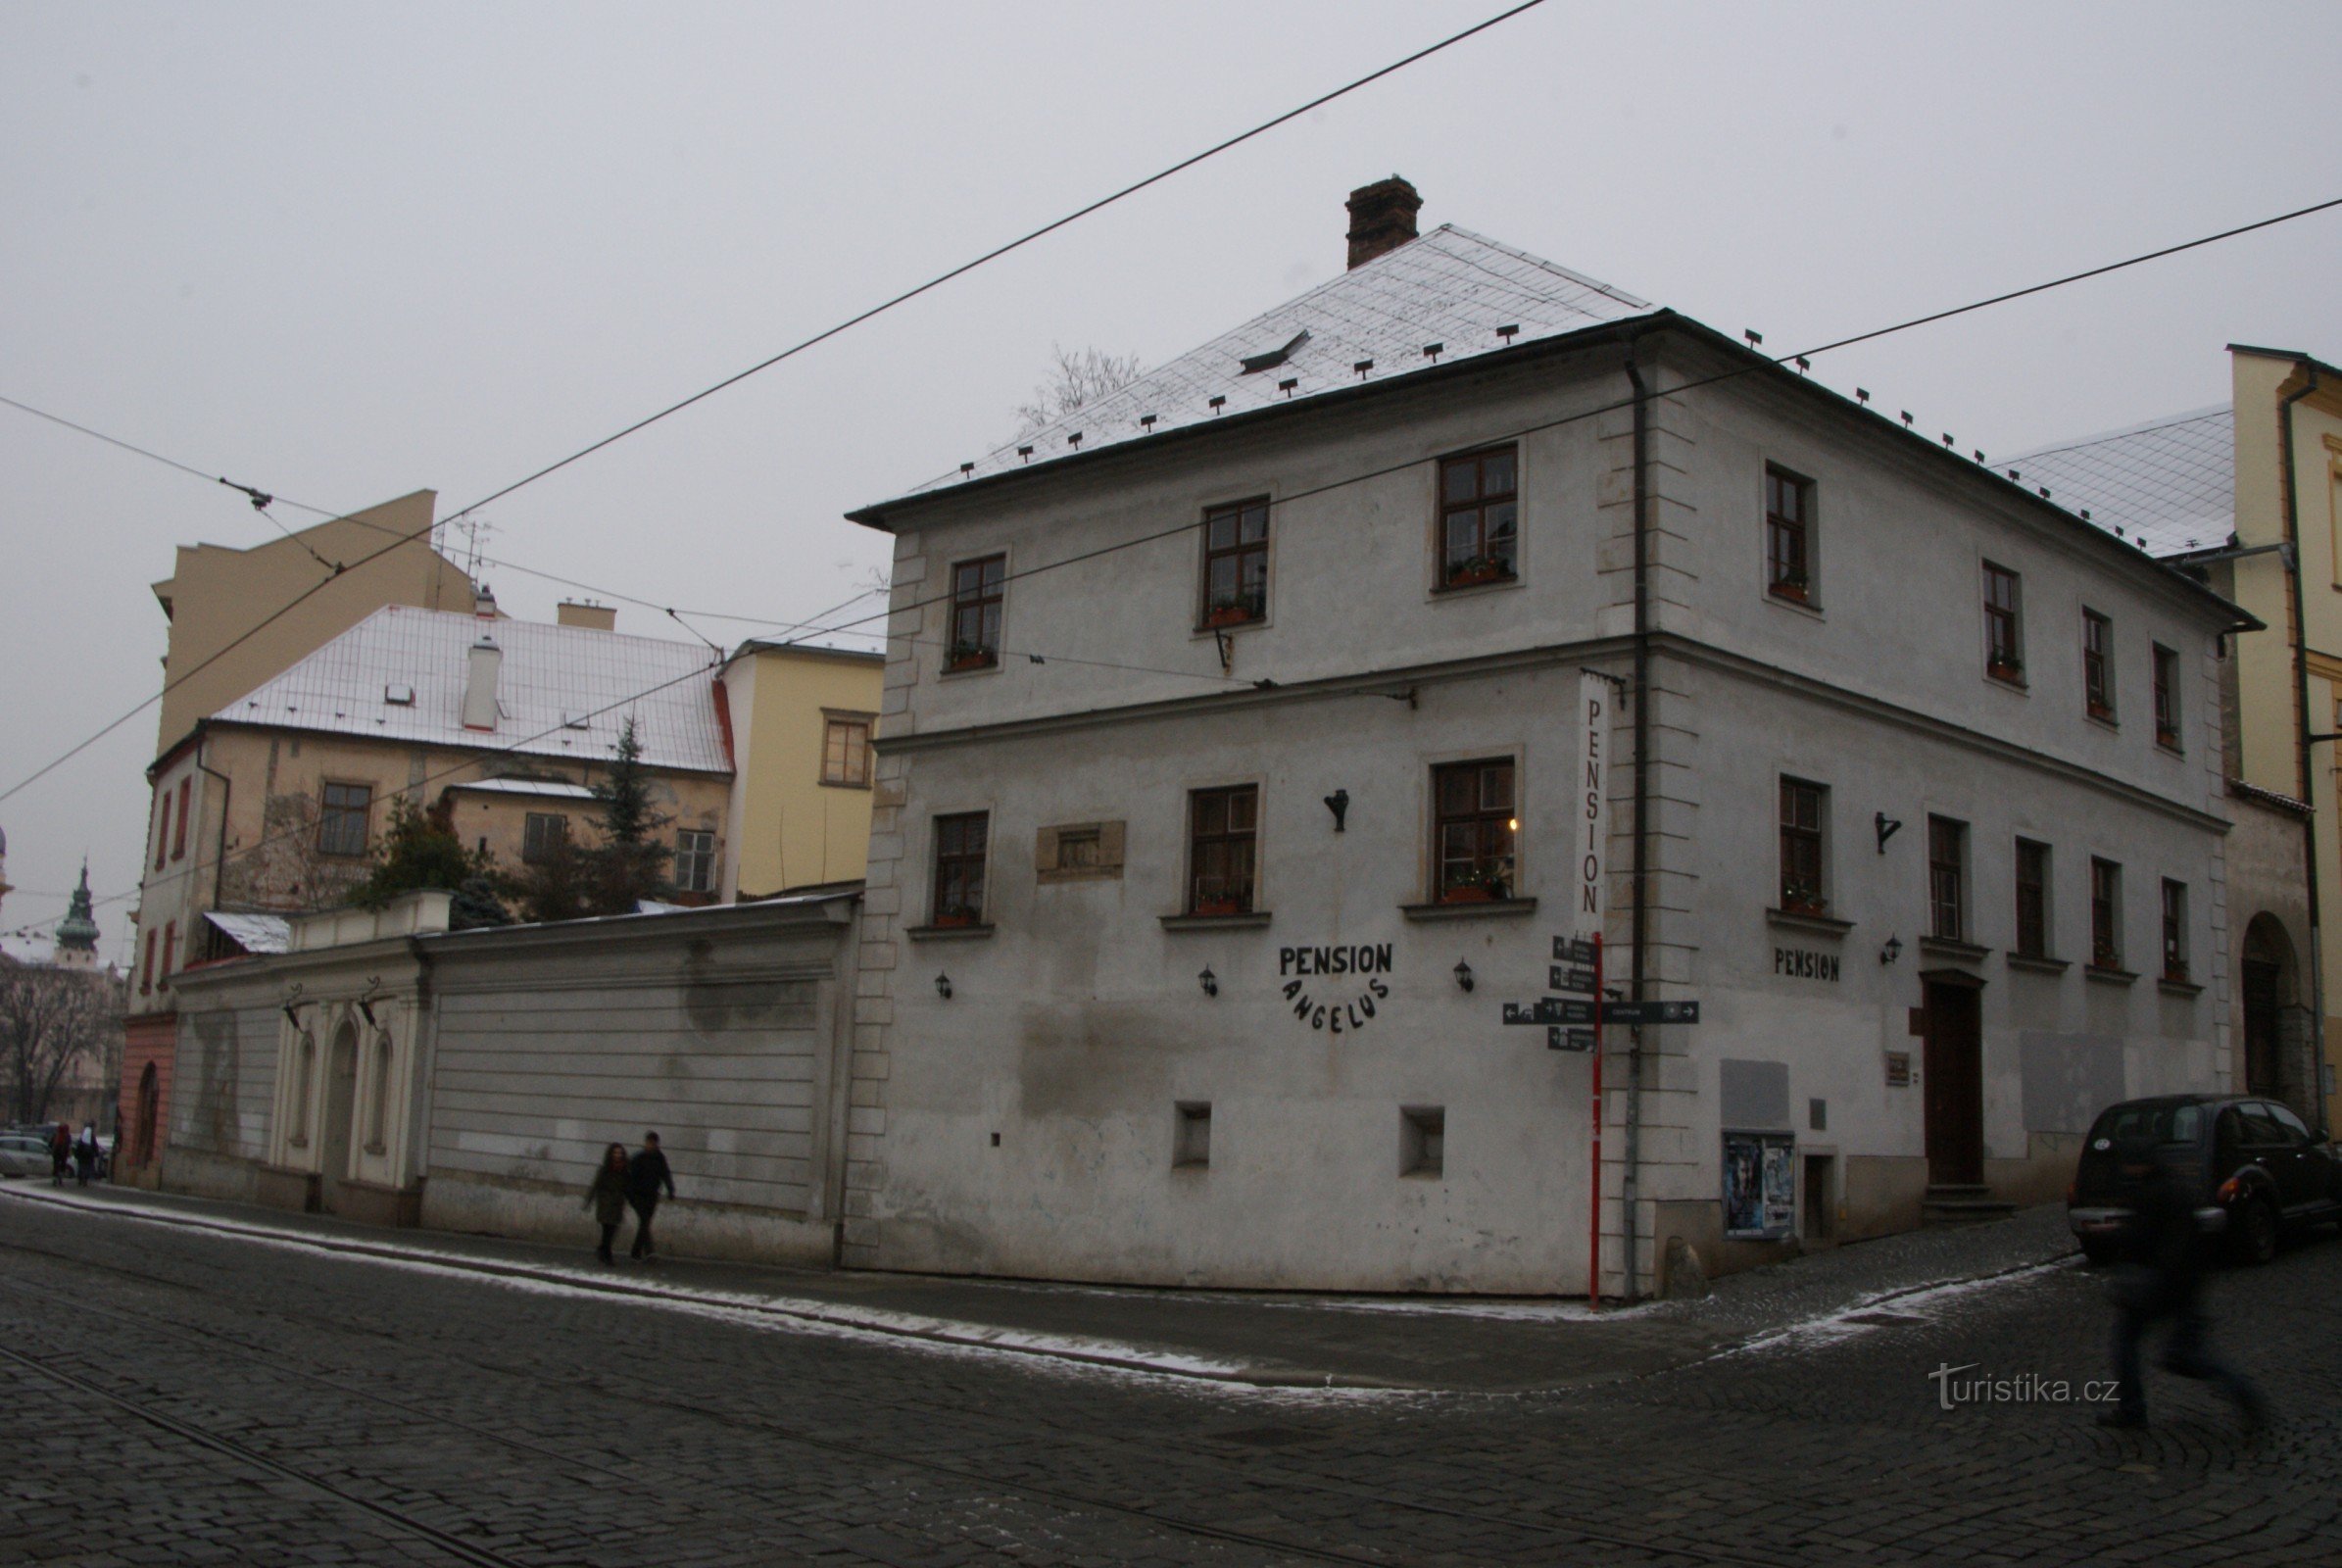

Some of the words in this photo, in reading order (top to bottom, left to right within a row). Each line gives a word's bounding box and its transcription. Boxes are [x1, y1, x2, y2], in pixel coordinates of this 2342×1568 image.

[1583, 699, 1600, 913] PENSION
[1280, 944, 1392, 975] PENSION
[1775, 947, 1839, 982] PENSION
[1283, 978, 1389, 1033] ANGELUS
